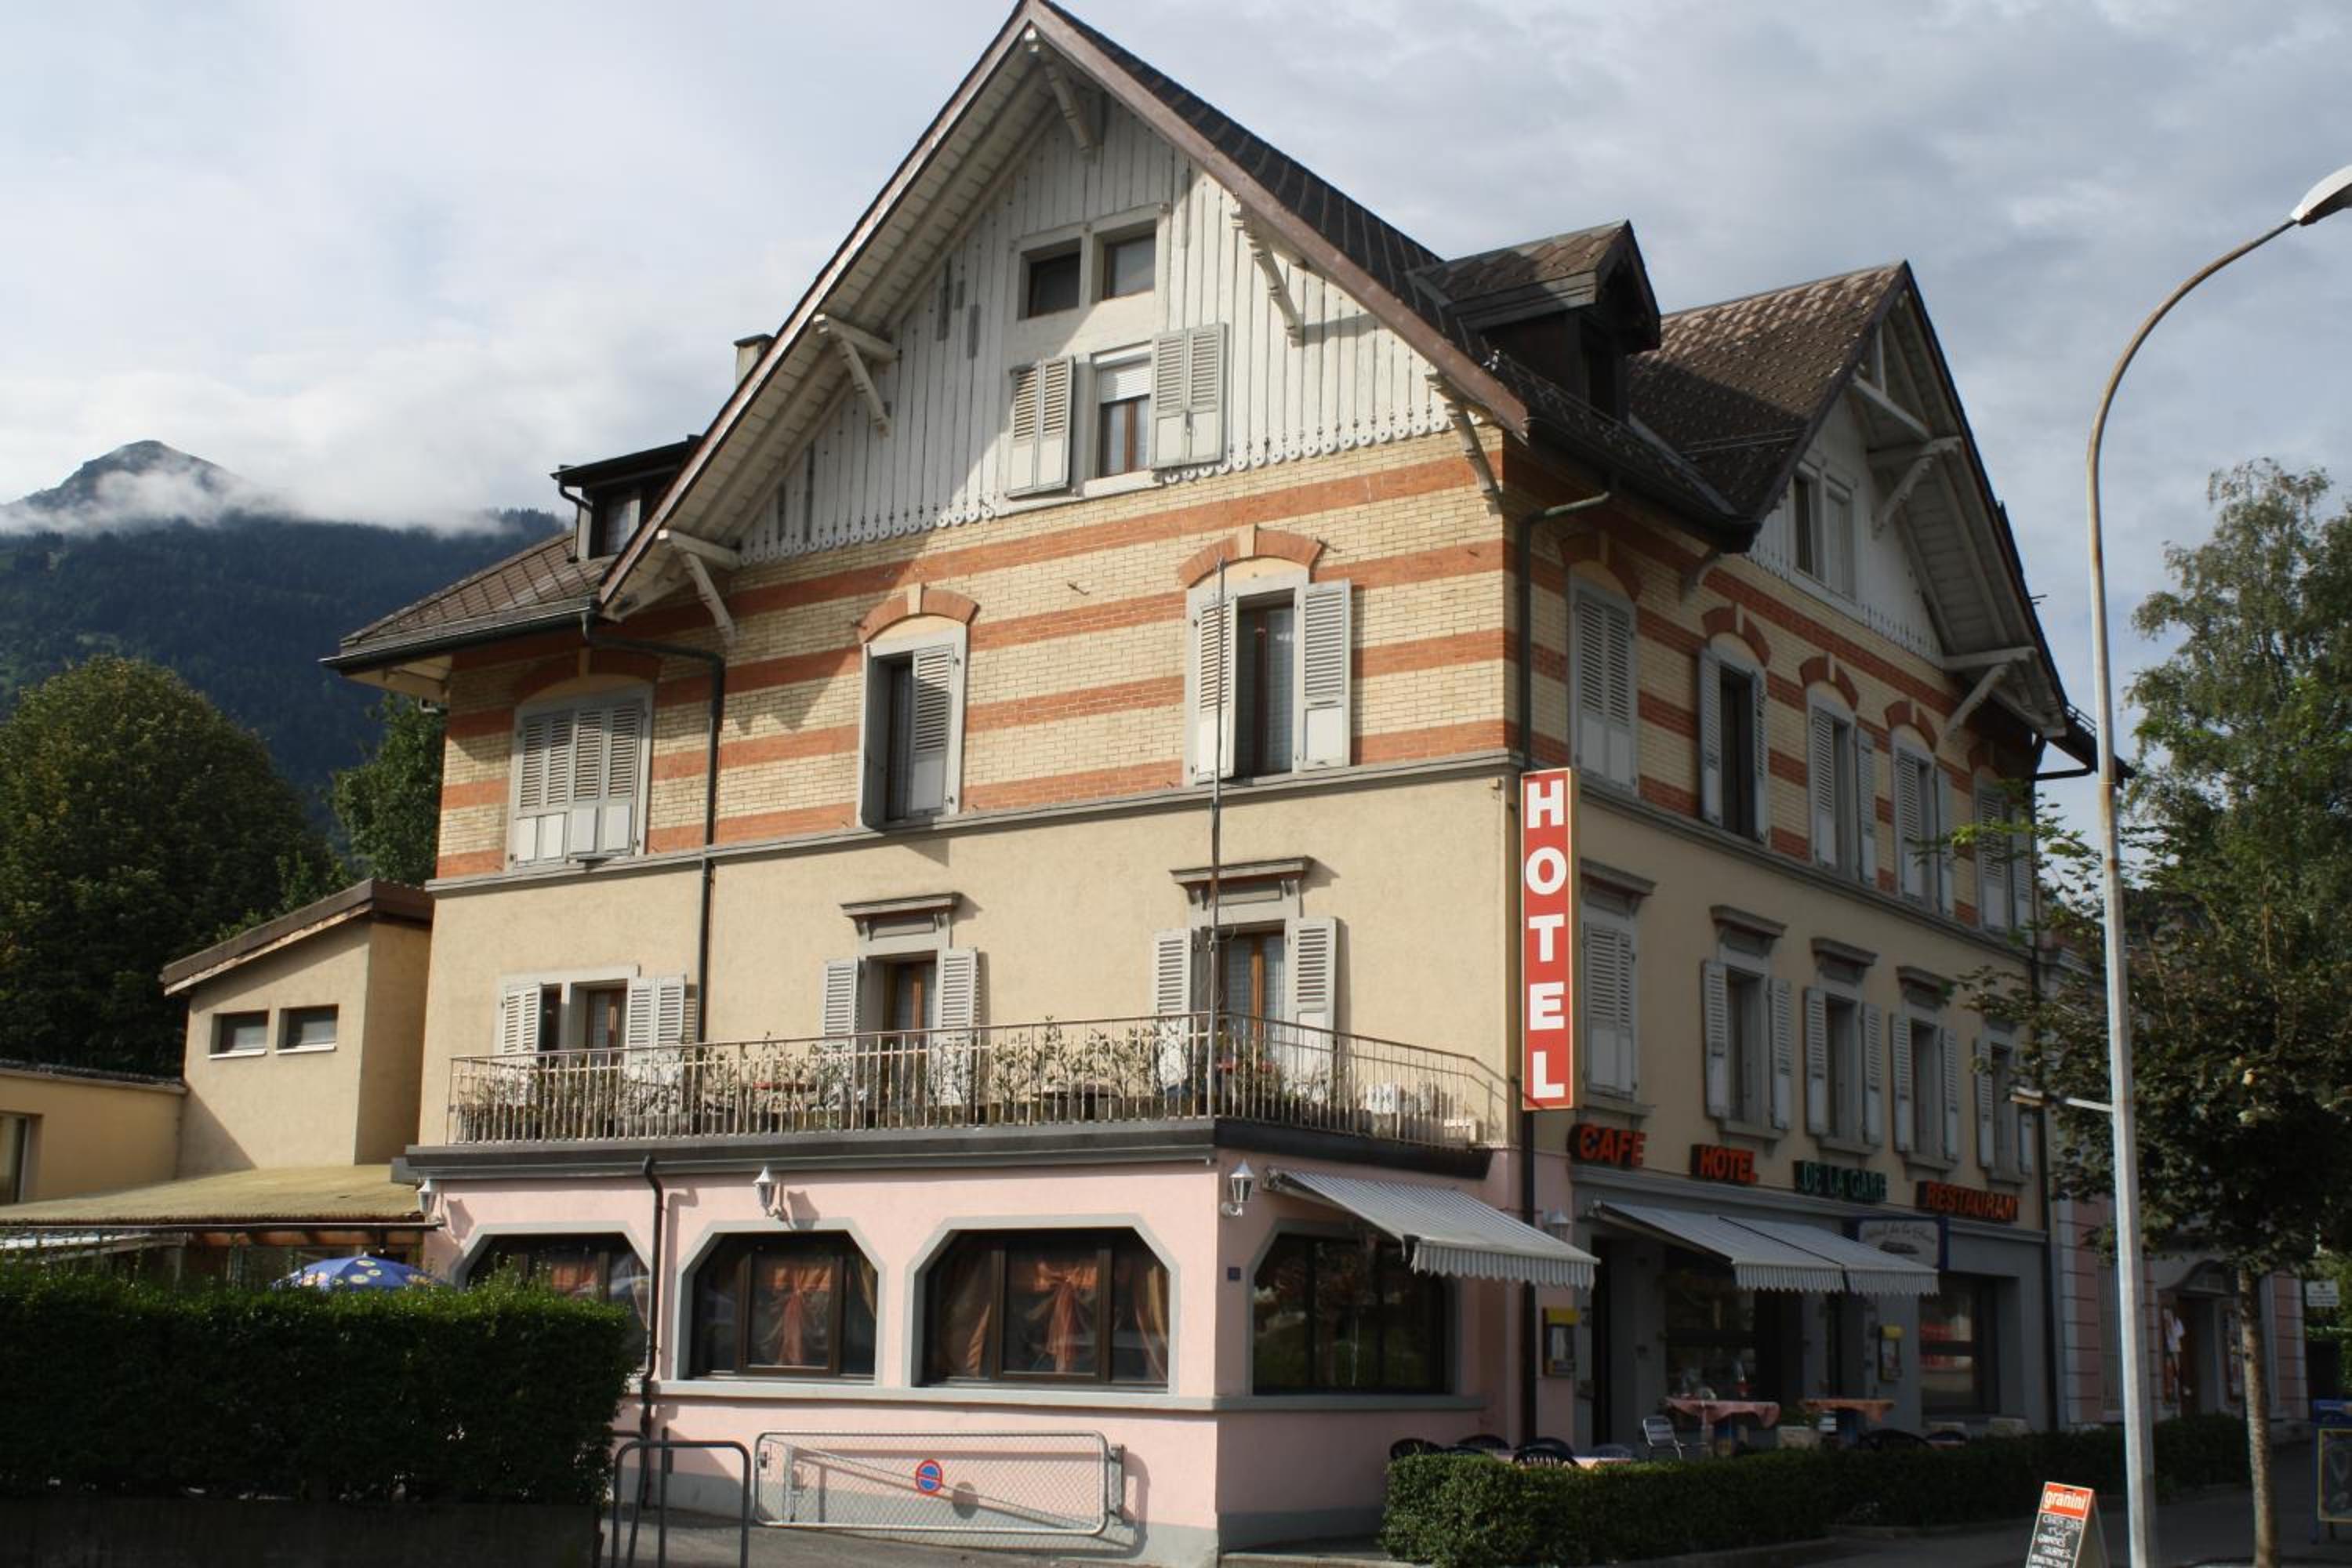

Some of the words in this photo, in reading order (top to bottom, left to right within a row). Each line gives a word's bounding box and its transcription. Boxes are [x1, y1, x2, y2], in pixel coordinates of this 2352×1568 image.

[1525, 779, 1568, 1099] HOTEL
[1700, 1145, 1758, 1184] HOTEL
[1803, 1162, 1823, 1191] DE
[1828, 1167, 1845, 1196] LA
[1850, 1170, 1886, 1204] GARE
[2044, 1490, 2086, 1510] granini
